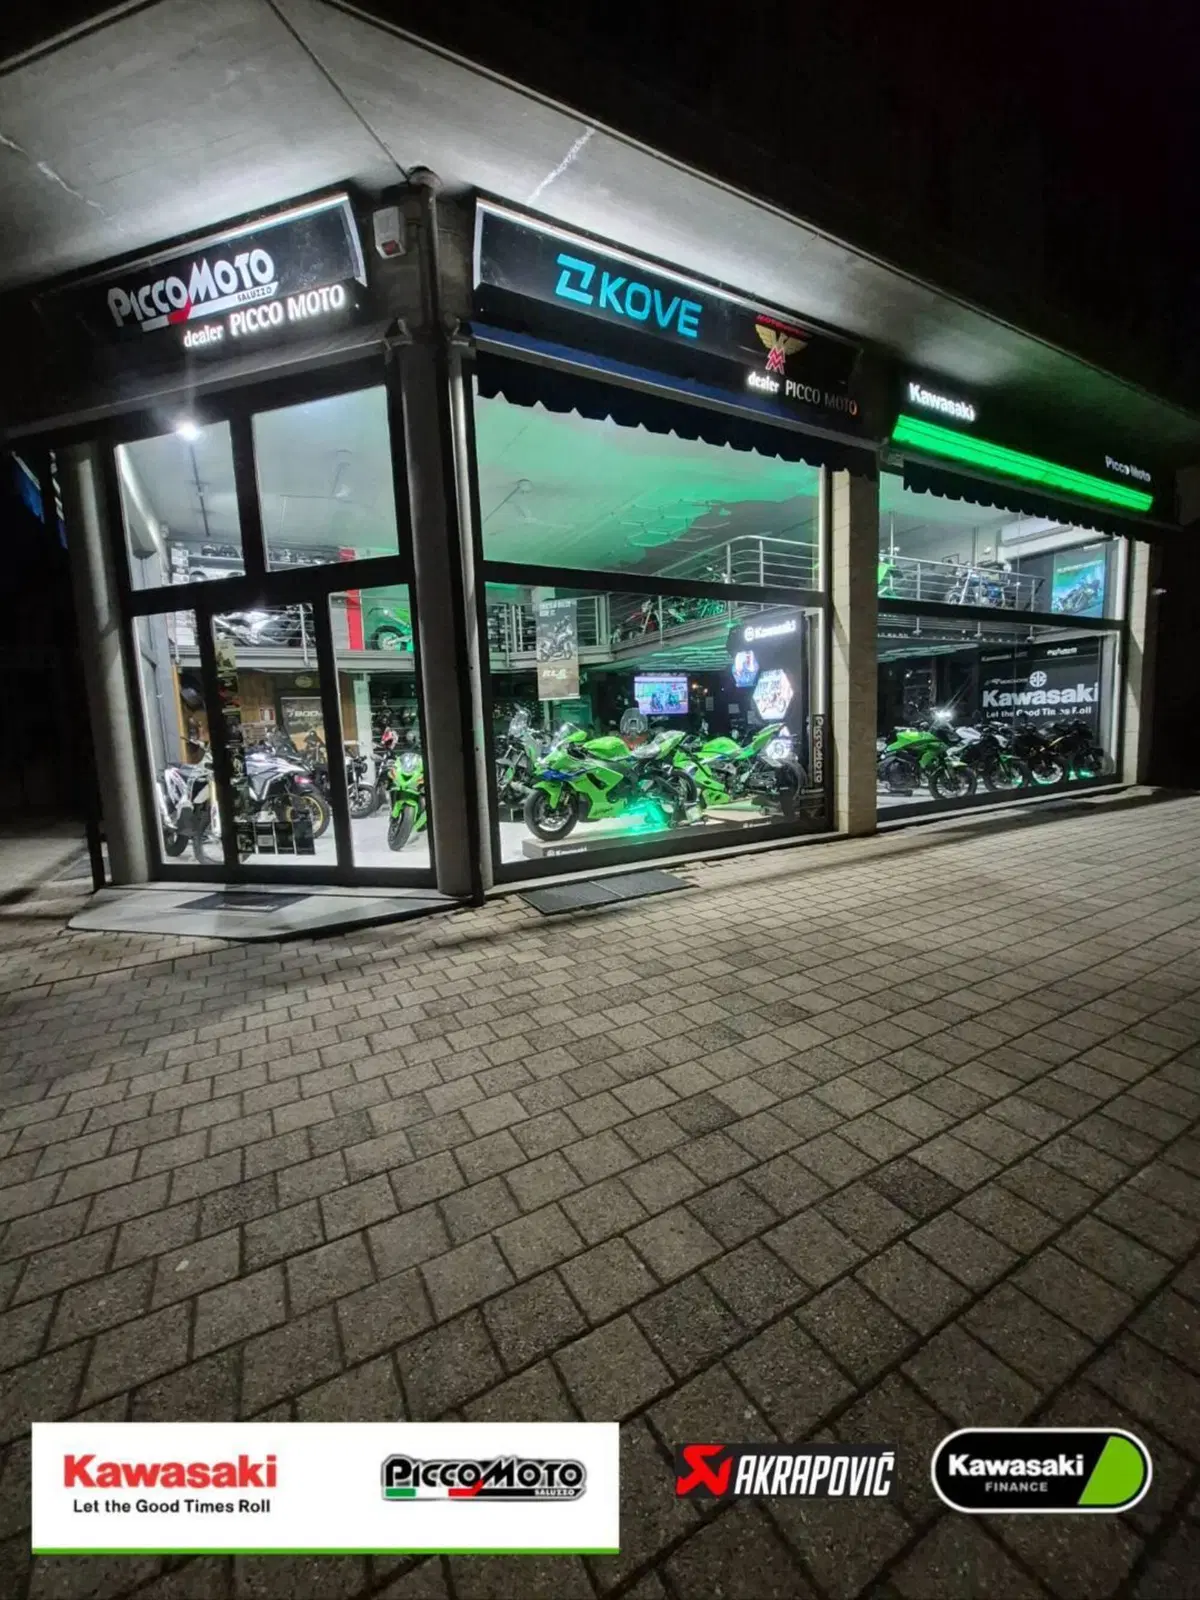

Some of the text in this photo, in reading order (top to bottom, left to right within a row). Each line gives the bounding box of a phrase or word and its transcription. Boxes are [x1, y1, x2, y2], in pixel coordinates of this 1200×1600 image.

[237, 285, 273, 303] SALUZZO
[601, 271, 702, 338] KOVE
[184, 284, 345, 348] dealer PICCO MOTO
[748, 371, 858, 416] dealer PICCO MOTO
[909, 382, 975, 422] Kawasaki
[1105, 454, 1151, 482] Picco Moto
[982, 682, 1099, 707] Kawasaki
